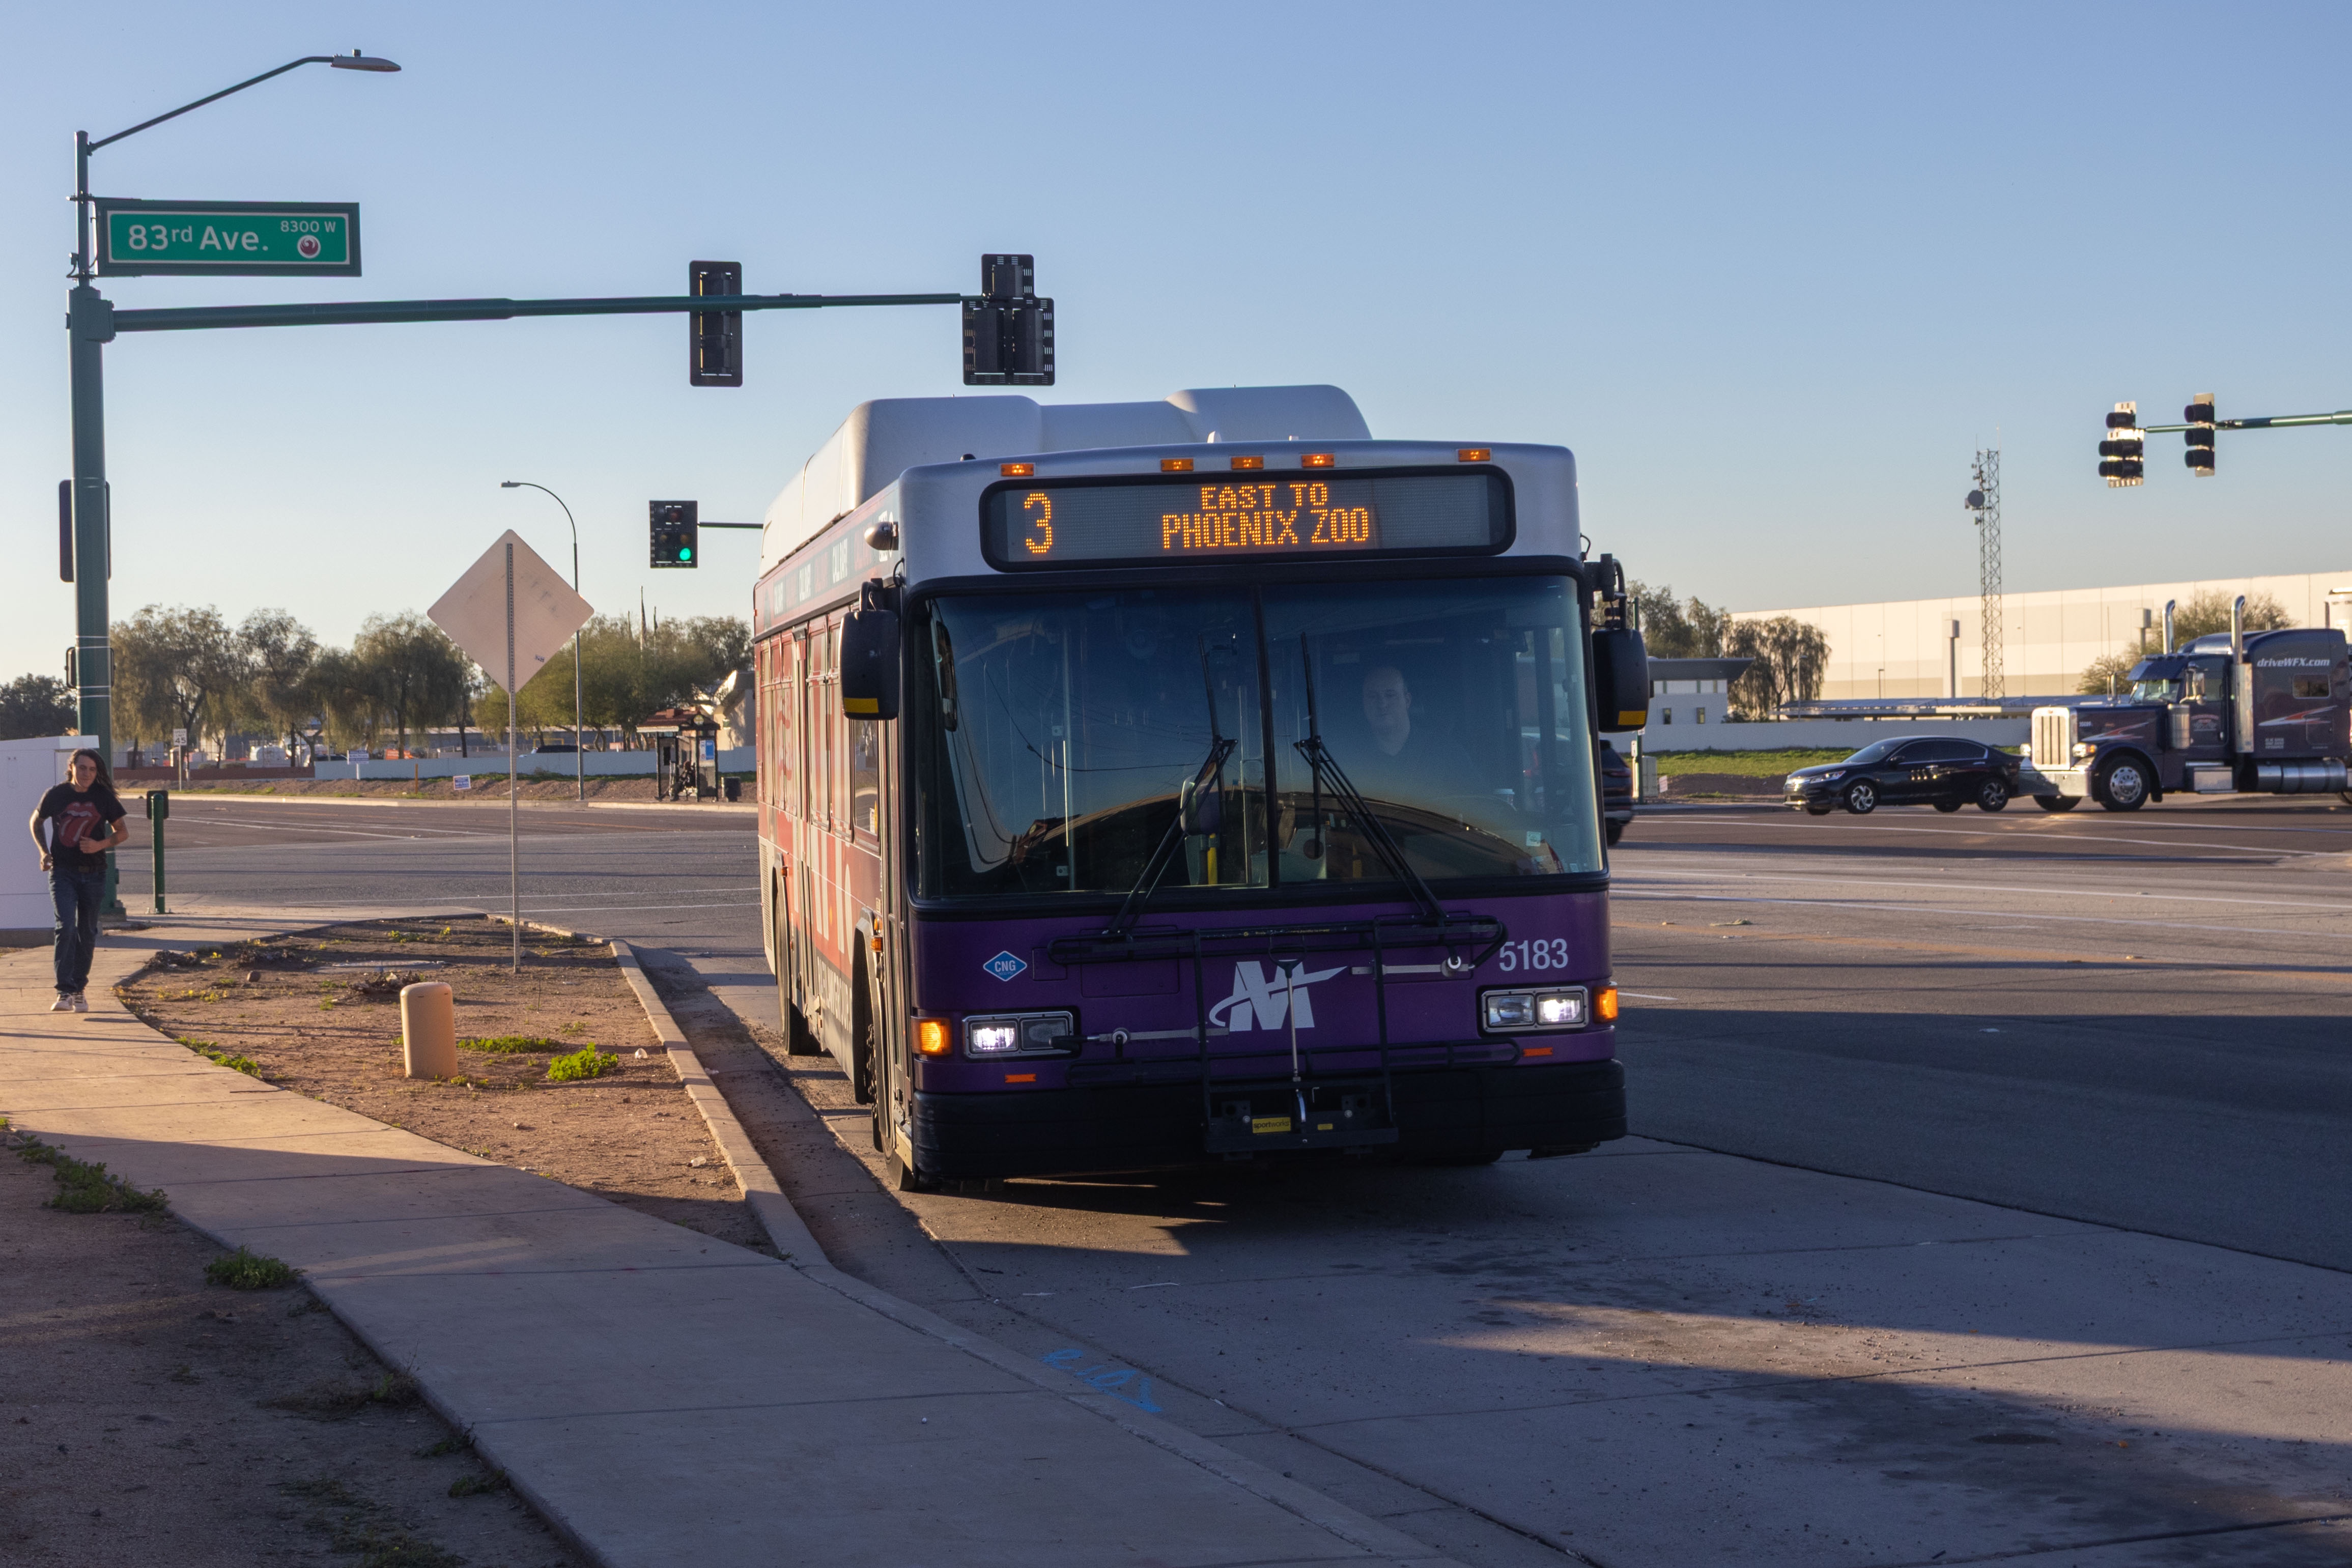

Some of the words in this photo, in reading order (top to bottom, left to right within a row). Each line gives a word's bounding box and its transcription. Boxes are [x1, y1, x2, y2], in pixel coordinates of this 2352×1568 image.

[128, 224, 193, 250] 83rd
[199, 225, 269, 251] Ave.
[280, 220, 320, 233] 8300
[324, 221, 336, 233] W
[1201, 484, 1277, 510] EAST
[1289, 482, 1328, 507] TO
[1024, 492, 1053, 553] 3
[1162, 509, 1298, 549] PHOENIX
[1310, 507, 1369, 544] ZOO
[2256, 658, 2330, 667] driveWFX.com
[995, 960, 1016, 973] CNG
[1499, 938, 1568, 971] 5183
[1253, 1121, 1290, 1129] sportworks
